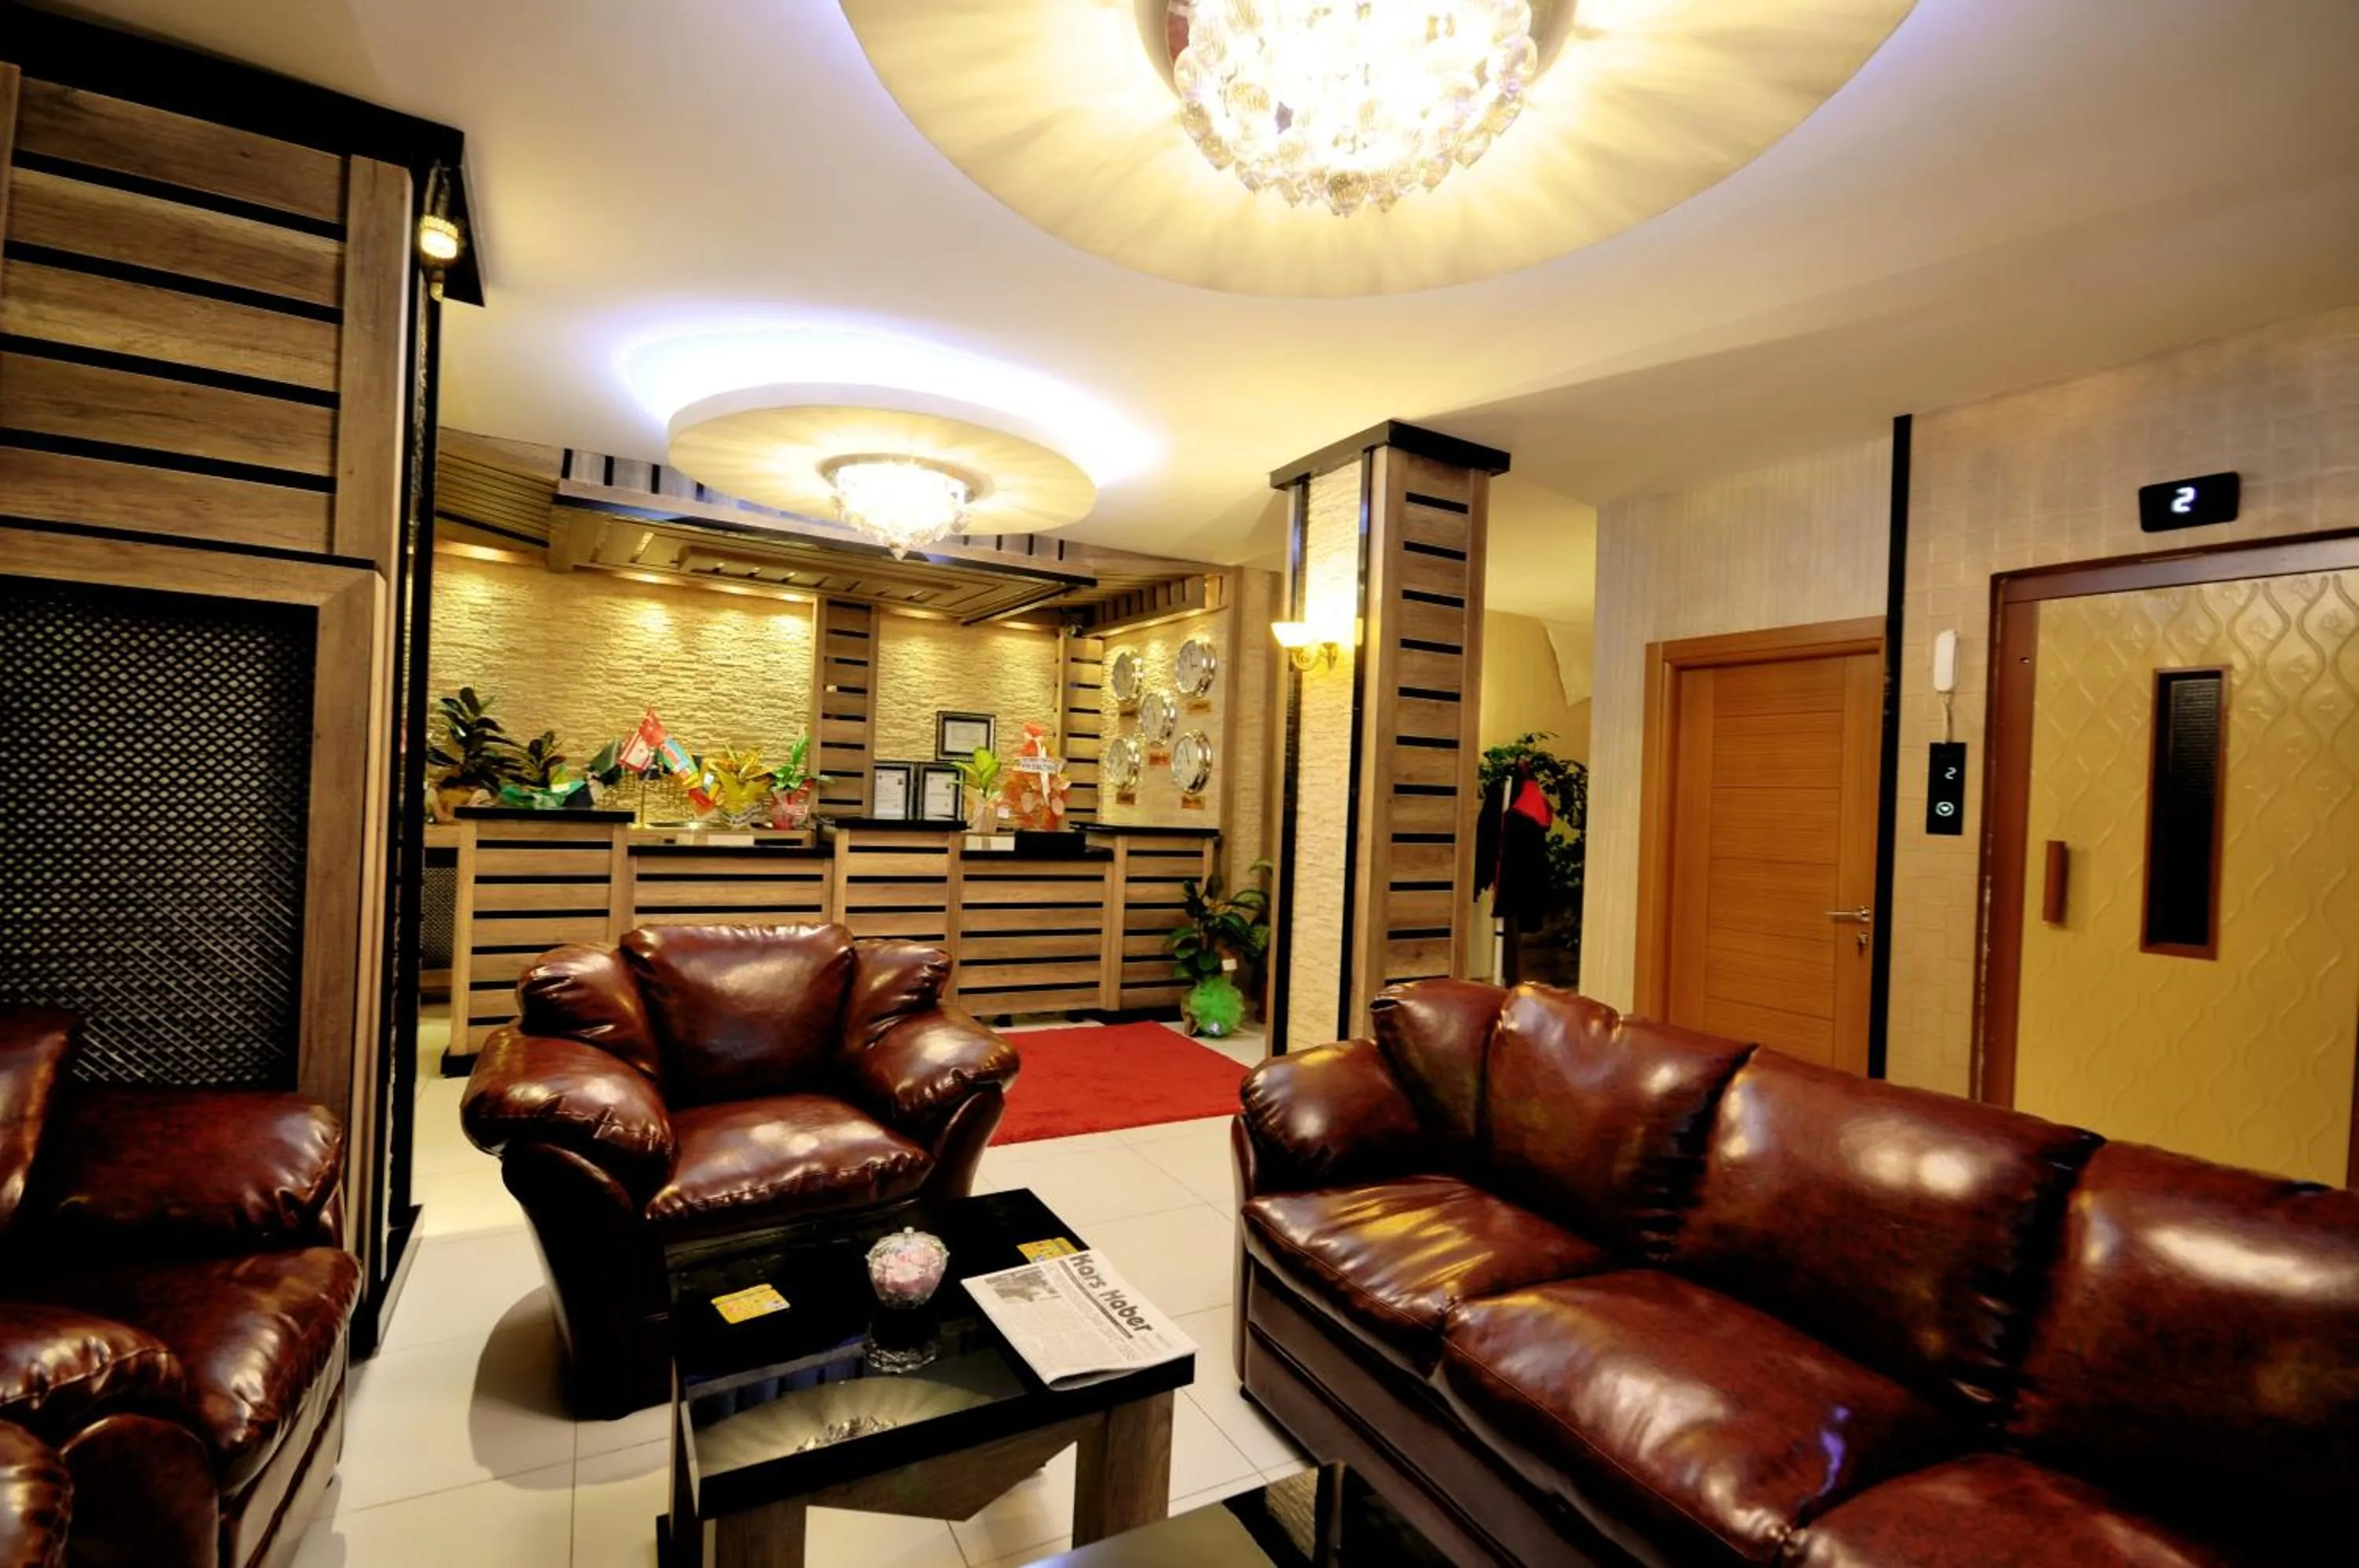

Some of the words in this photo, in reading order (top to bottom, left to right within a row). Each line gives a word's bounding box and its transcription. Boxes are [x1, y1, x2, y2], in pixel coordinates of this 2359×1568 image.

[2171, 486, 2196, 513] 2
[1945, 767, 1957, 779] 2
[1069, 1253, 1107, 1289] Kars
[1099, 1289, 1154, 1332] Haber
